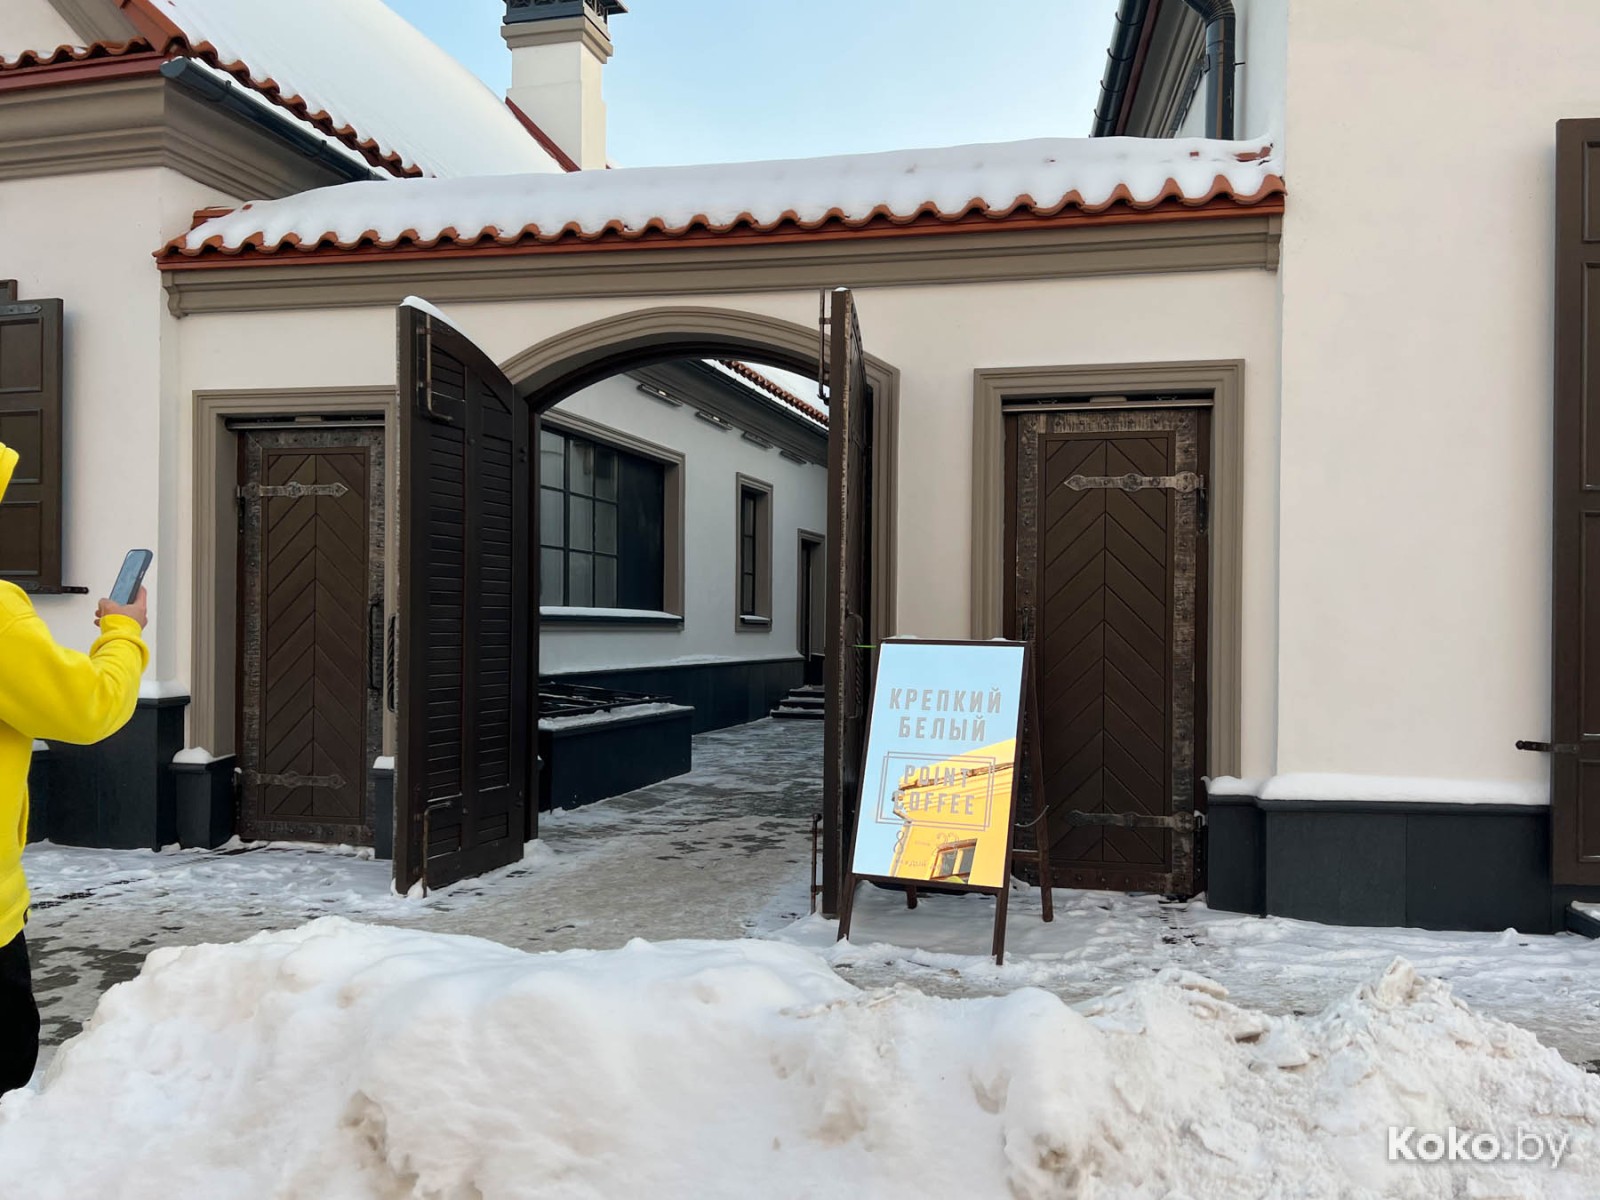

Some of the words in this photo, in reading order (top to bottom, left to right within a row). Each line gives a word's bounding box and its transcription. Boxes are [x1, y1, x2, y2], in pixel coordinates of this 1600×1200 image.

[889, 687, 1002, 714] КРЕПКИЙ
[898, 715, 986, 742] БЕЛЫЙ
[904, 765, 971, 788] POINT
[893, 790, 975, 815] COFFEE
